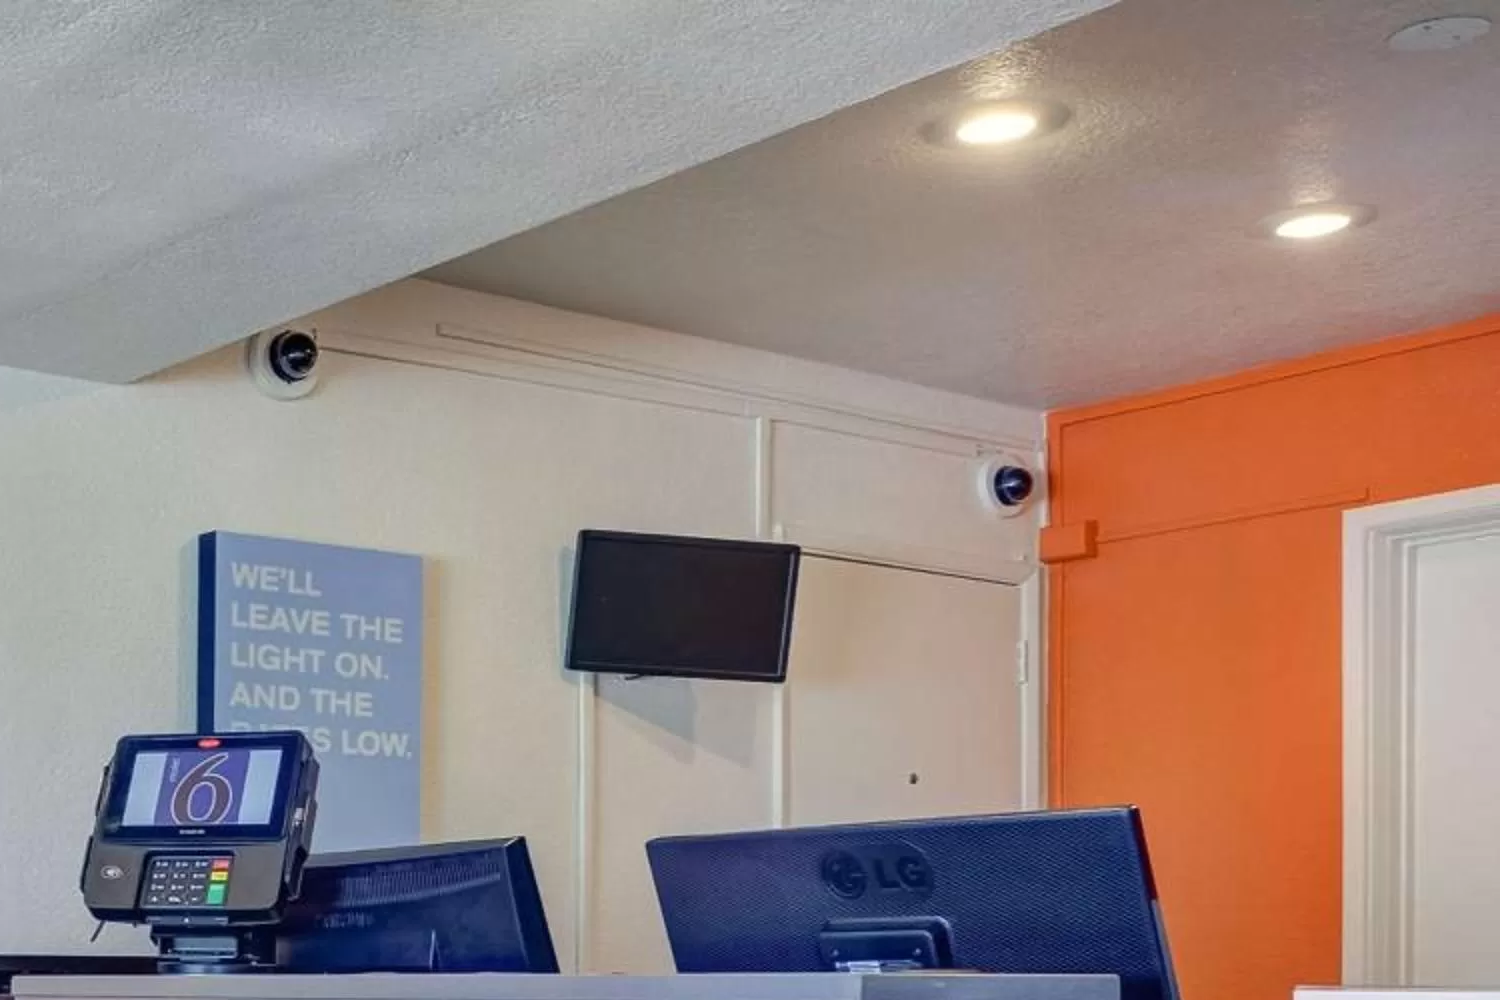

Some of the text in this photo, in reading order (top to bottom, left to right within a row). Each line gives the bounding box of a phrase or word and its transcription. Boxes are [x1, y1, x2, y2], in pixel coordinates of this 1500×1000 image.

[231, 562, 322, 597] WE'LL
[231, 601, 404, 643] LEAVE THE
[231, 642, 389, 680] LIGHT ON.
[229, 681, 373, 717] AND THE
[342, 728, 413, 759] LOW.
[873, 855, 927, 889] LG
